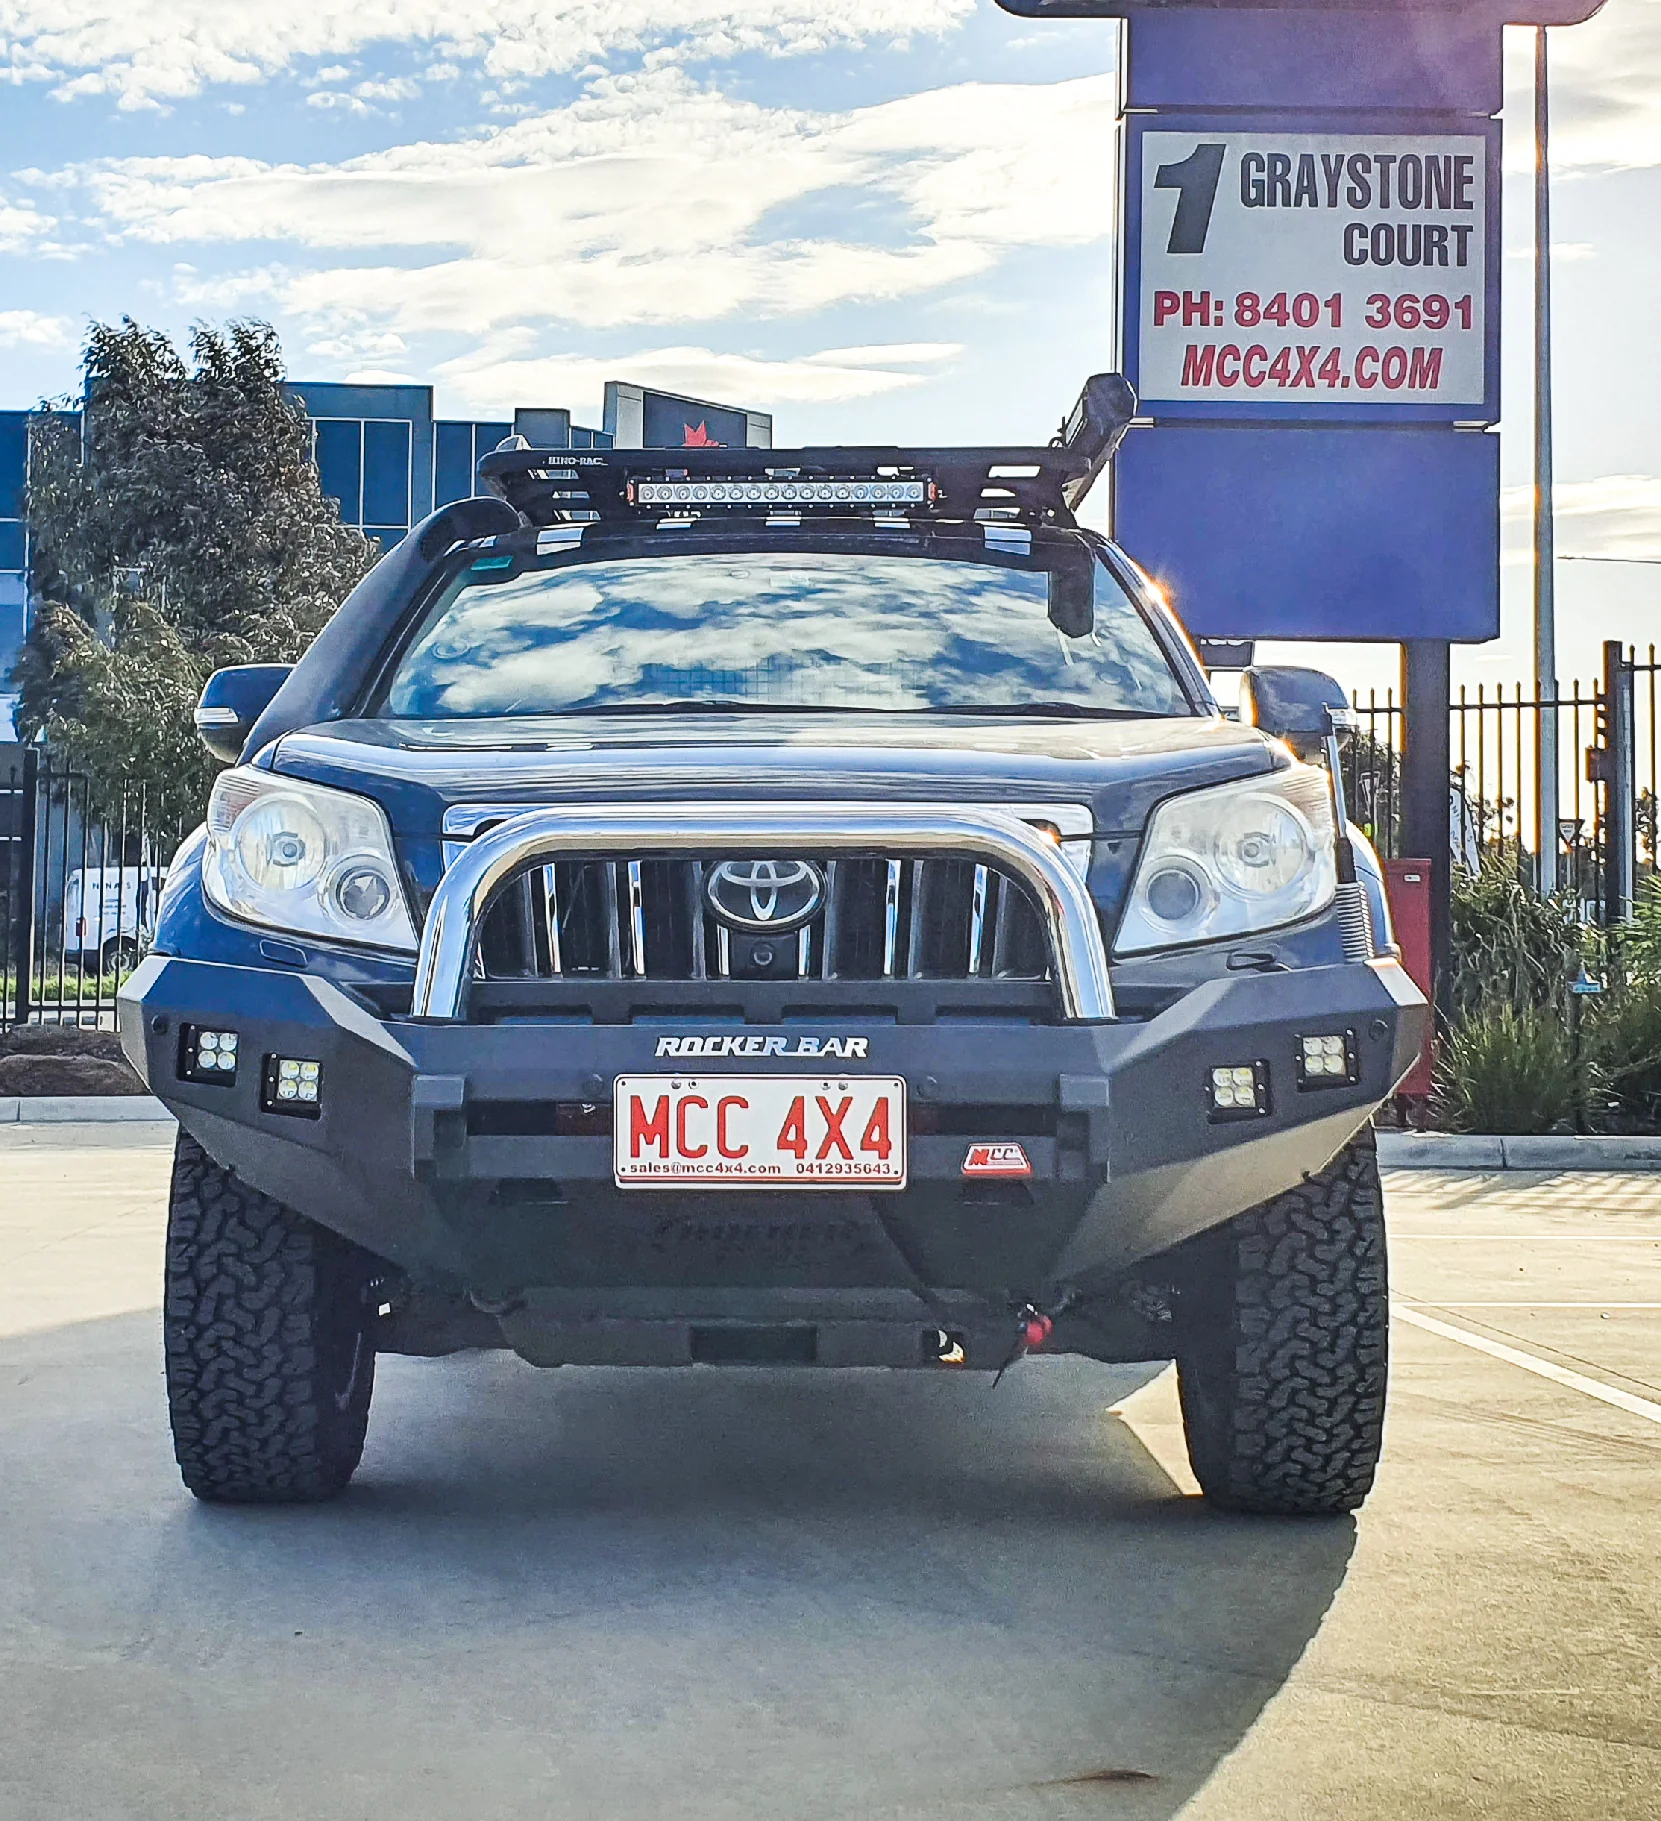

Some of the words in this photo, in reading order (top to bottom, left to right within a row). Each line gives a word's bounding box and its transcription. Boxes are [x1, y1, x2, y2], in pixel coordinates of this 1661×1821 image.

[1153, 143, 1227, 254] 1
[1240, 152, 1474, 210] GRAYSTONE
[1343, 222, 1474, 267] COURT
[1153, 290, 1224, 327] PH:
[1234, 292, 1342, 328] 8401
[1364, 293, 1472, 330] 3691
[1181, 344, 1444, 390] MCC4X4.COM
[654, 1036, 788, 1057] ROCKER
[797, 1036, 869, 1058] BAR
[629, 1094, 749, 1160] MCC
[777, 1095, 892, 1161] 4X4
[630, 1162, 782, 1175] sales@mcc4x4.com
[796, 1162, 891, 1175] 0412935643
[968, 1147, 1021, 1166] MCC
